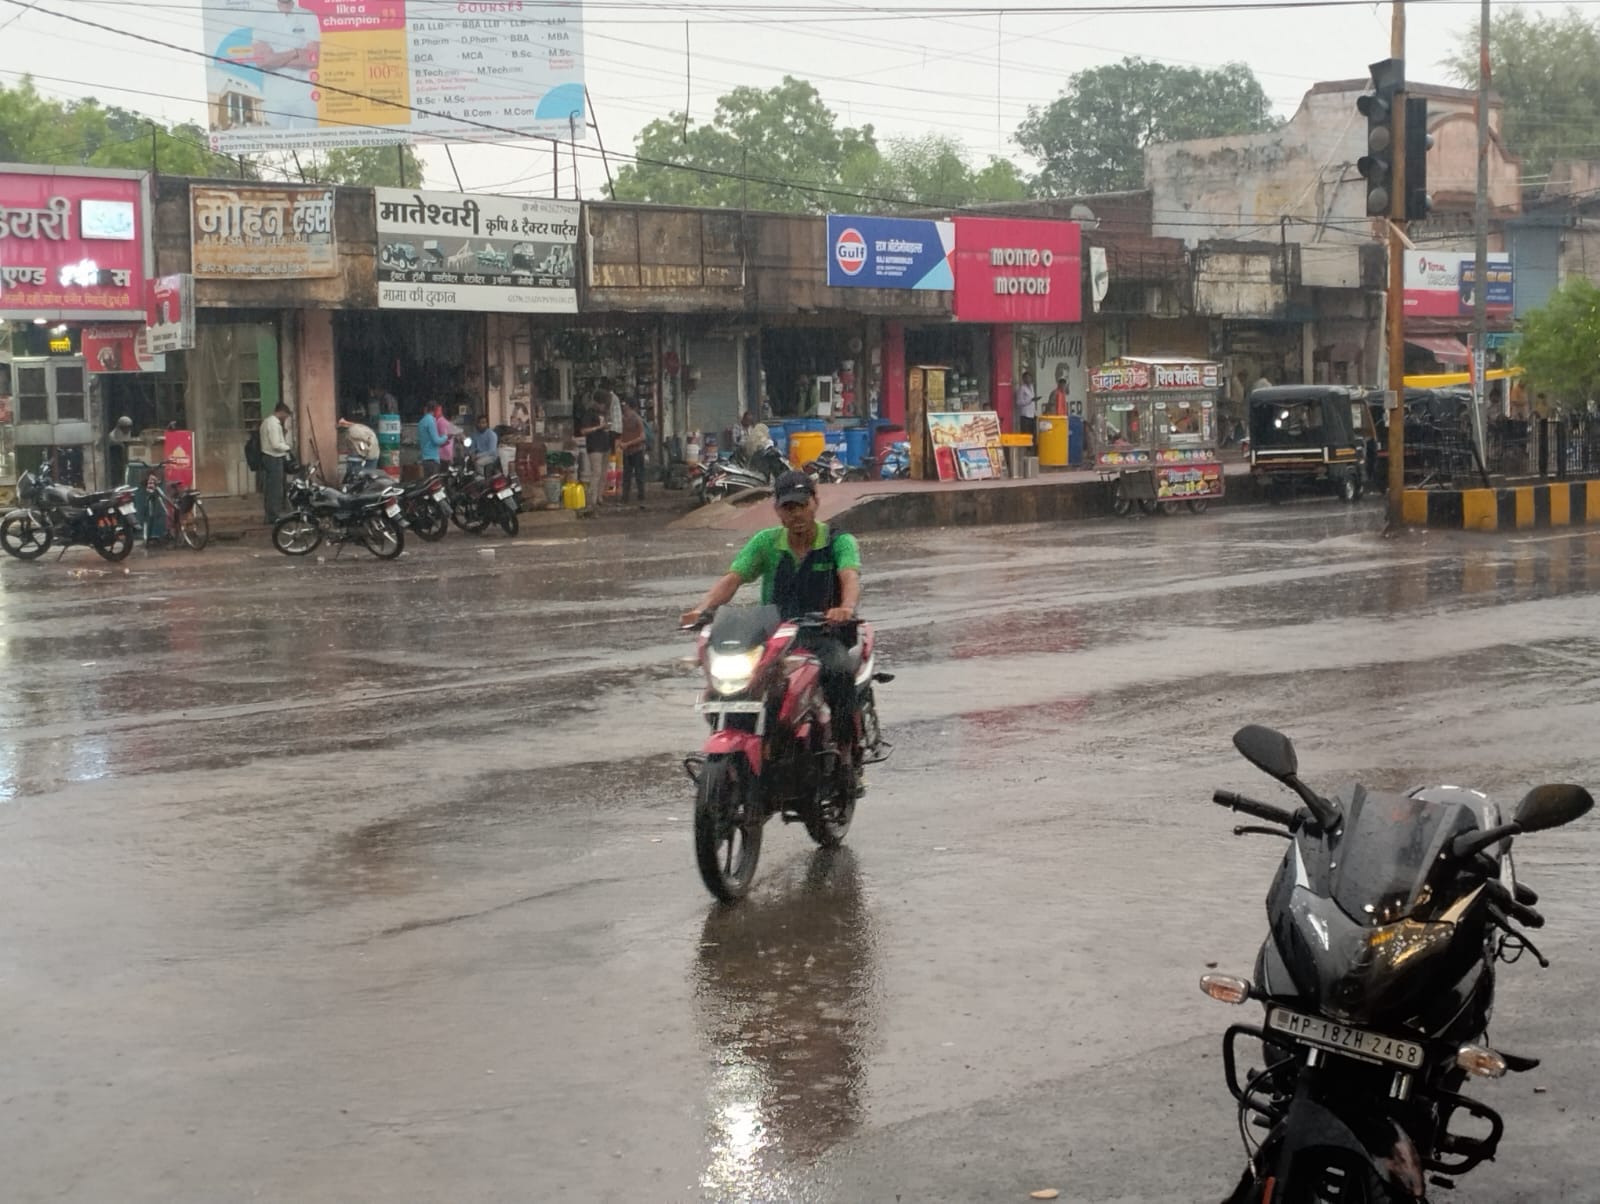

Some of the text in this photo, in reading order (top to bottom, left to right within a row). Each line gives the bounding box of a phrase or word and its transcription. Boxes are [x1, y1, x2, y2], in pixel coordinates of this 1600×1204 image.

[336, 4, 366, 14] like a
[457, 1, 523, 13] COURSES
[323, 15, 381, 28] champion
[413, 37, 449, 46] B.Pharm
[510, 33, 529, 42] BBA
[547, 31, 570, 41] MBA
[414, 48, 571, 63] BCA MCA B.Sc M.Sc
[415, 65, 509, 77] B.Tech M.Tech
[416, 96, 436, 105] B.Sc
[443, 94, 466, 104] M.Sc
[463, 107, 492, 118] B.Com
[503, 106, 535, 116] M.Com
[380, 194, 480, 236] मातेश्वरी
[485, 215, 509, 237] कृषि
[511, 219, 519, 234] &
[838, 244, 865, 259] Gulf
[2, 267, 47, 289] एण्ड
[994, 276, 1051, 295] MOTORS
[383, 288, 407, 303] मामा
[409, 285, 425, 303] की
[1372, 1037, 1417, 1062] 2468
